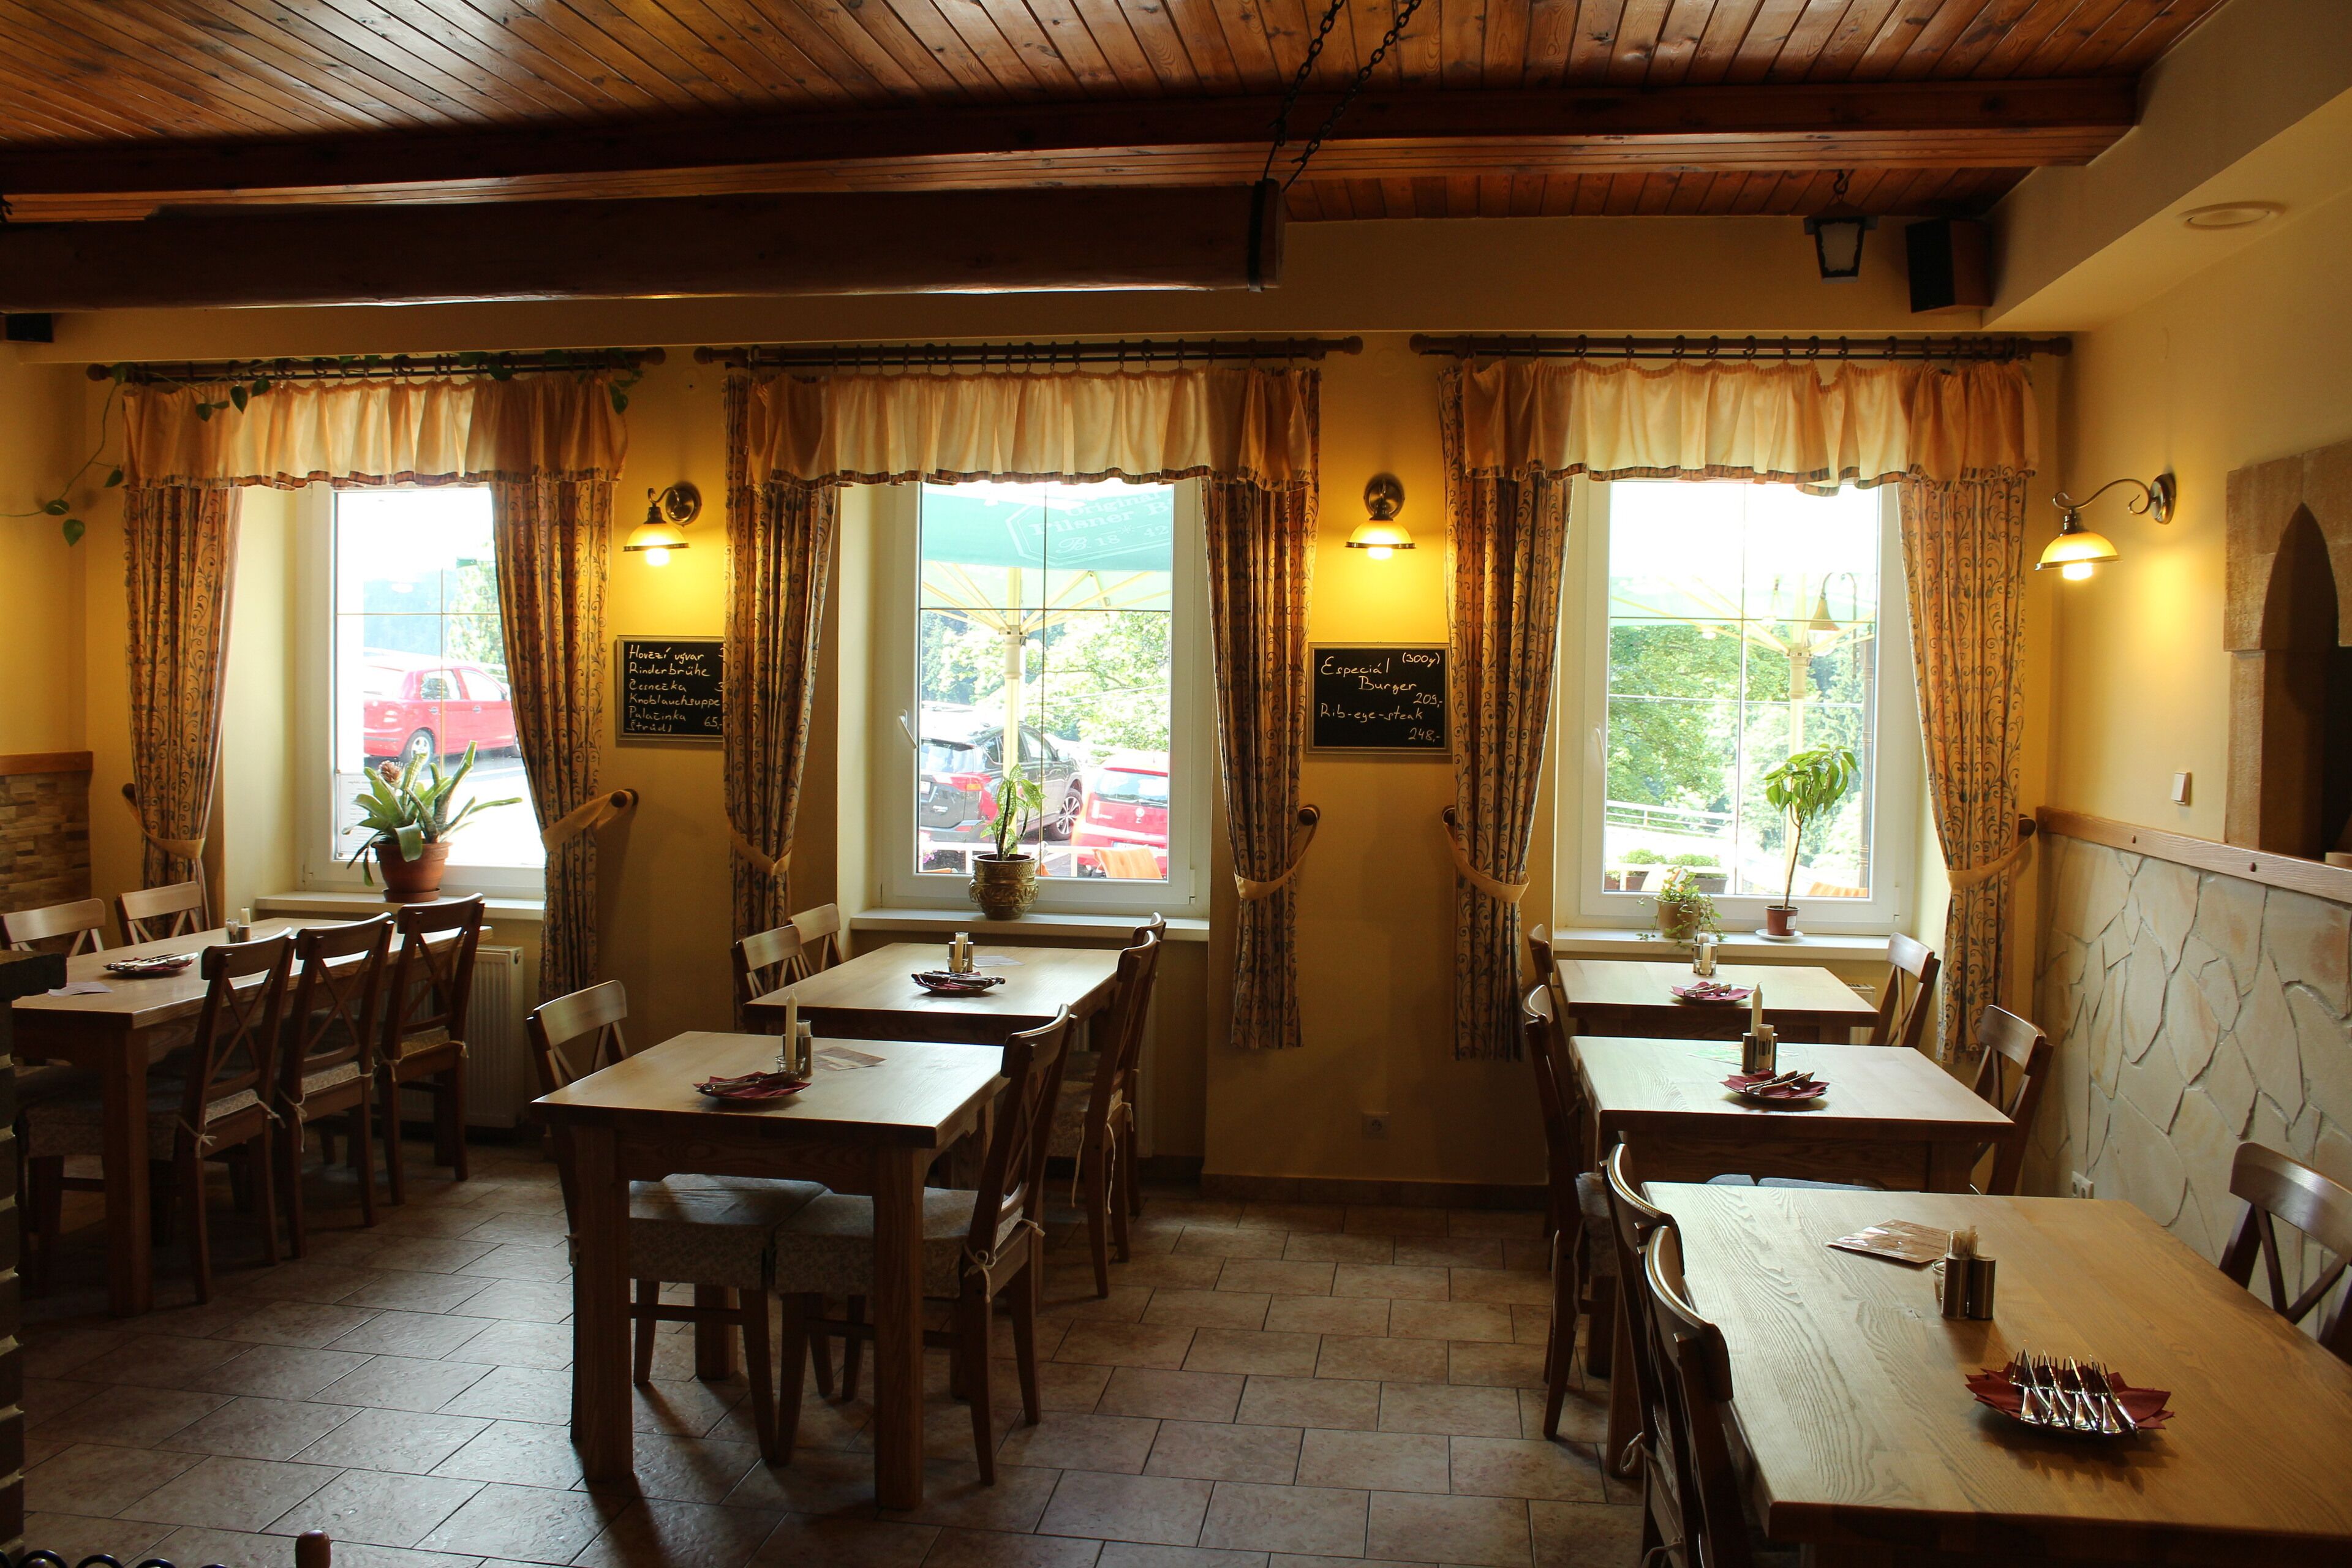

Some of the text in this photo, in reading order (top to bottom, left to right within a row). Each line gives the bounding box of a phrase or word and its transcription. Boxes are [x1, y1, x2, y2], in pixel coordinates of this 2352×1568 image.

[1095, 534, 1120, 546] 18
[1144, 525, 1169, 537] 42
[629, 662, 710, 676] Rinderbrühe
[1321, 656, 1390, 677] Especiál
[629, 679, 687, 692] Česnečka
[1358, 676, 1417, 695] Burger
[629, 693, 720, 709] Knoblauchsuppe
[628, 706, 686, 722] Palačinka
[1321, 703, 1423, 723] Rib-eye-steak
